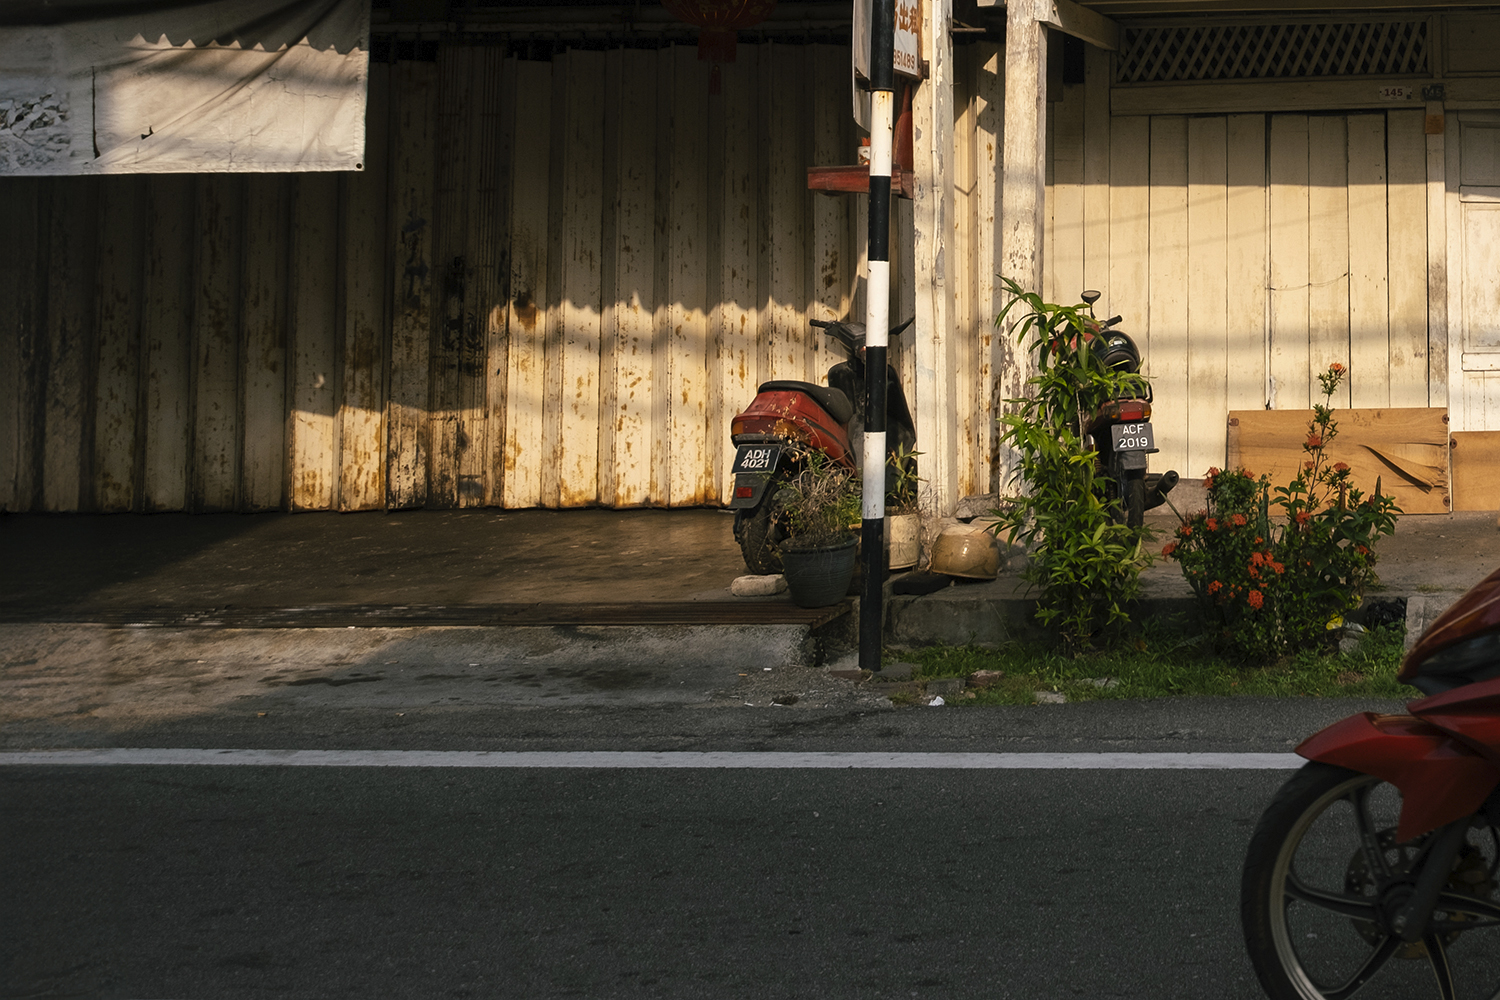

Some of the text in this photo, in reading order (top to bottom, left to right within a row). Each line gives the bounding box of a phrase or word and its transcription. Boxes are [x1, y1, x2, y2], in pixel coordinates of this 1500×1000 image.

[1385, 88, 1403, 96] 145
[1122, 423, 1144, 434] ACF
[1118, 437, 1148, 448] 2019
[744, 449, 771, 459] ADH
[740, 458, 770, 469] 4021
